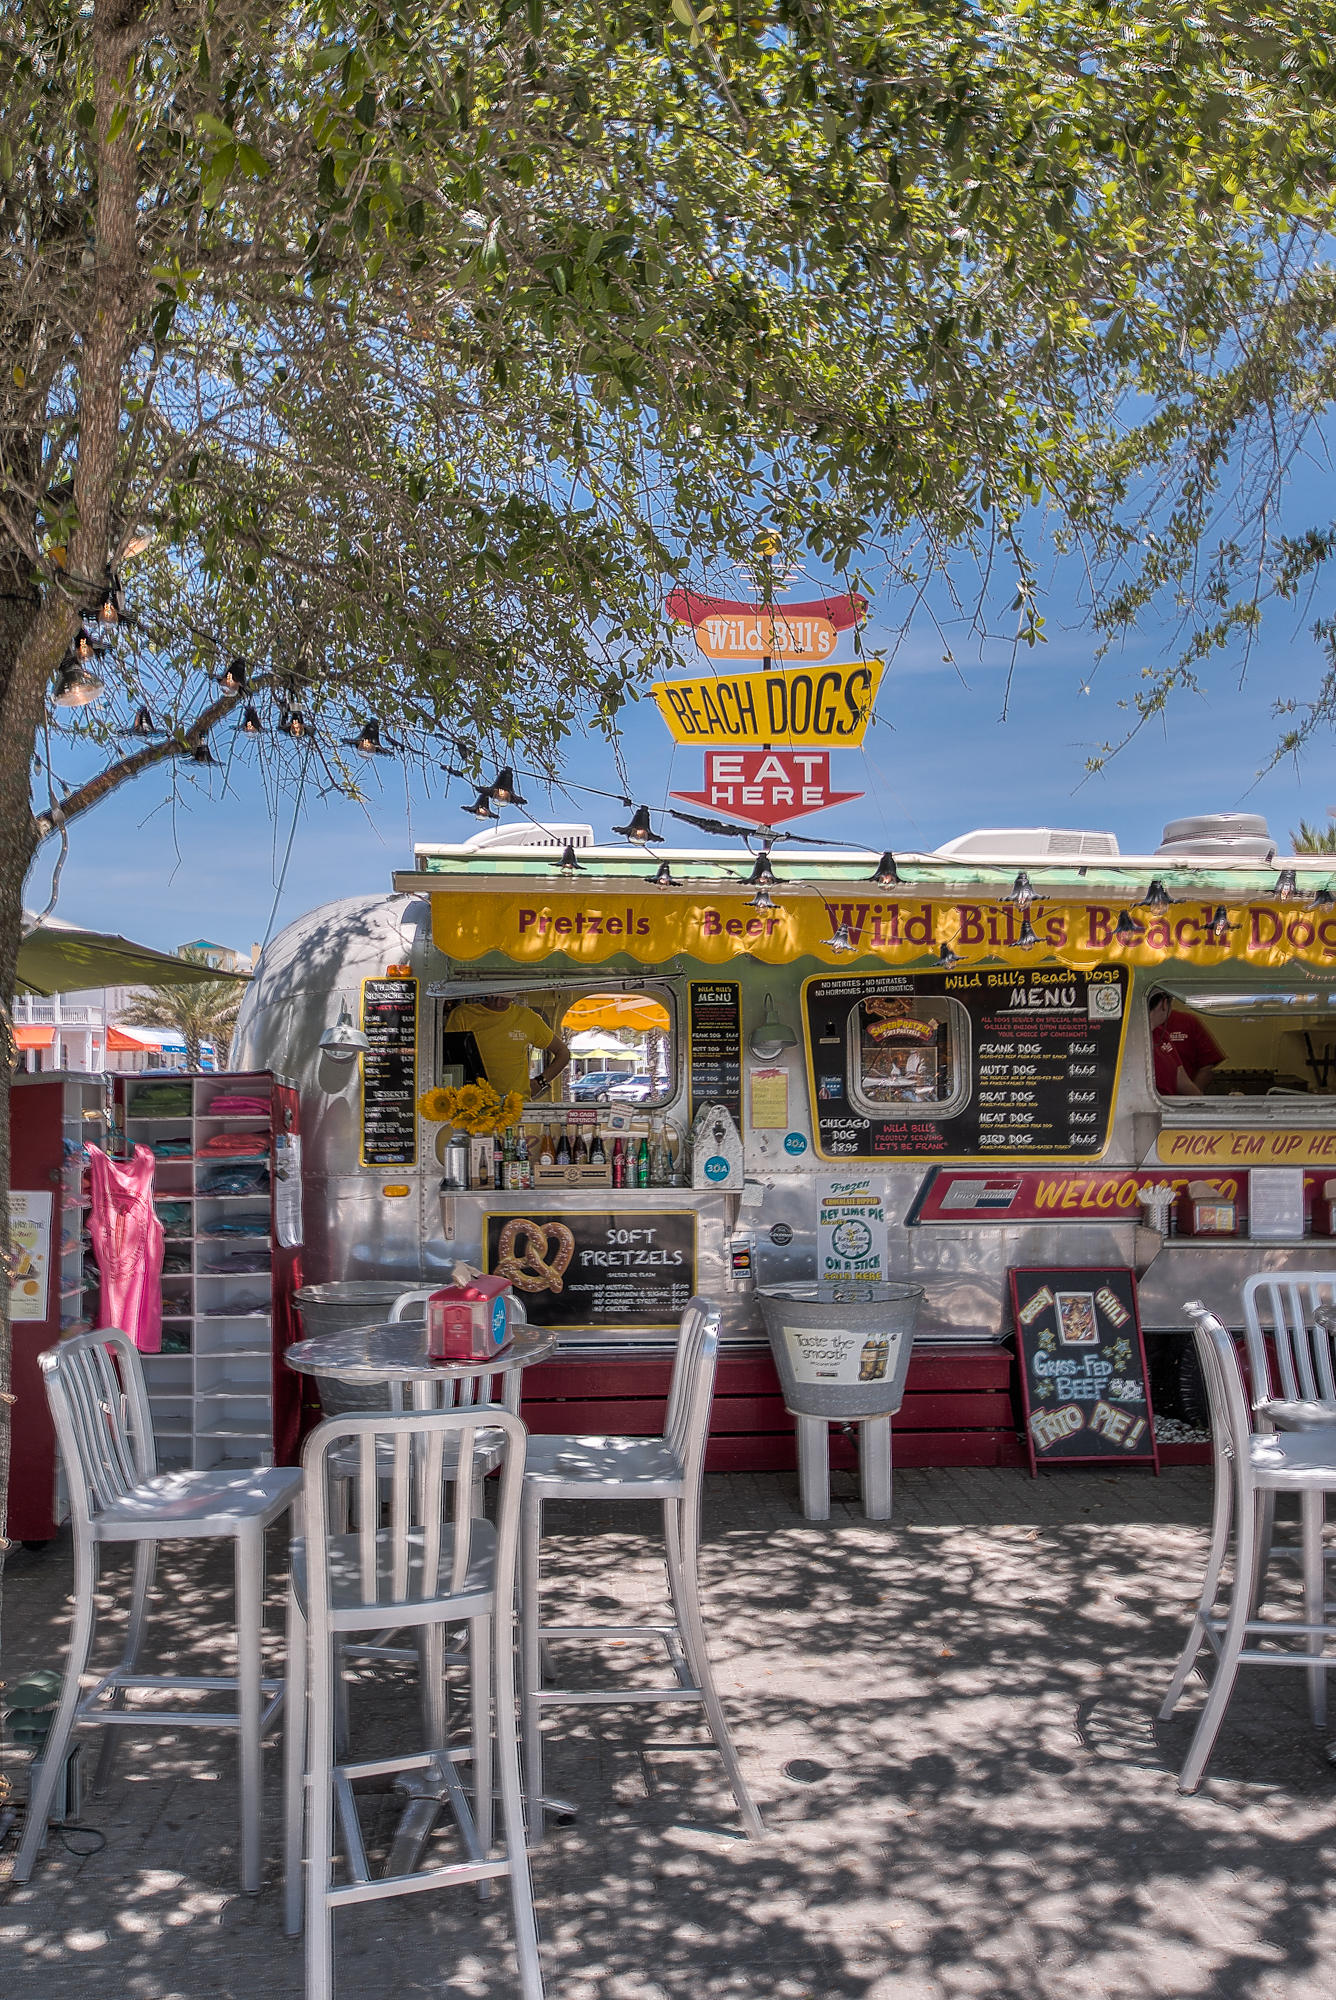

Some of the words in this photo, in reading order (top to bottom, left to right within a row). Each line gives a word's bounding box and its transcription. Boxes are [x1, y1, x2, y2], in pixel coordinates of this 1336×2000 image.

[705, 620, 763, 652] Wild
[772, 621, 830, 653] Bill's
[664, 681, 758, 736] BEACH
[765, 669, 873, 736] DOGS
[712, 755, 823, 783] EAT
[711, 786, 824, 806] HERE
[518, 909, 650, 936] Pretzels
[704, 911, 779, 936] Beer
[825, 903, 936, 947] Wild
[955, 904, 1067, 948] Bill's
[1087, 904, 1231, 948] Beach
[821, 981, 831, 989] NO
[832, 980, 860, 988] NITRITES
[876, 977, 907, 986] NITRATES
[945, 974, 982, 990] Wild
[987, 971, 1026, 987] Bill's
[1031, 970, 1077, 985] Beach
[1083, 969, 1120, 984] Dogs
[698, 993, 731, 1002] MENU
[826, 988, 860, 996] HORMONES
[876, 985, 914, 993] ANTIBIOTICS
[1009, 987, 1077, 1008] MENU
[979, 1043, 1015, 1054] FRANK
[1018, 1043, 1042, 1054] DOG
[979, 1065, 1009, 1075] MUTT
[1012, 1065, 1037, 1075] DOG
[979, 1092, 1007, 1102] BRAT
[1010, 1092, 1035, 1102] DOG
[820, 1119, 870, 1129] CHICAGO
[979, 1113, 1006, 1123] HEAT
[1009, 1113, 1035, 1123] DOG
[883, 1123, 908, 1132] Wild
[911, 1123, 936, 1132] Bill's
[832, 1131, 857, 1140] DOG
[979, 1134, 1006, 1145] BIRD
[1009, 1134, 1034, 1145] DOG
[831, 1142, 859, 1154] $8.95
[875, 1143, 898, 1151] LET'S
[901, 1143, 912, 1151] BE
[1170, 1135, 1224, 1156] PICK
[1230, 1133, 1266, 1155] 'EM
[1271, 1135, 1303, 1156] UP
[831, 1180, 870, 1195] Frozen
[1035, 1178, 1188, 1209] WELCOE
[821, 1209, 839, 1220] KEY
[842, 1208, 866, 1216] LIME
[869, 1208, 884, 1222] PIE
[605, 1228, 657, 1245] SOFT
[580, 1250, 683, 1267] PRETZELS
[825, 1256, 841, 1270] ON
[845, 1261, 851, 1270] A
[854, 1254, 880, 1270] STICK
[824, 1271, 852, 1280] SOLD
[855, 1271, 882, 1281] HERE
[794, 1334, 828, 1347] Taste
[831, 1336, 855, 1349] the
[801, 1348, 847, 1360] smooth
[1032, 1351, 1114, 1377] GRASS-FED
[1056, 1377, 1109, 1400] BEEF
[1030, 1405, 1085, 1449] FRITO
[1090, 1403, 1146, 1448] PIE!
